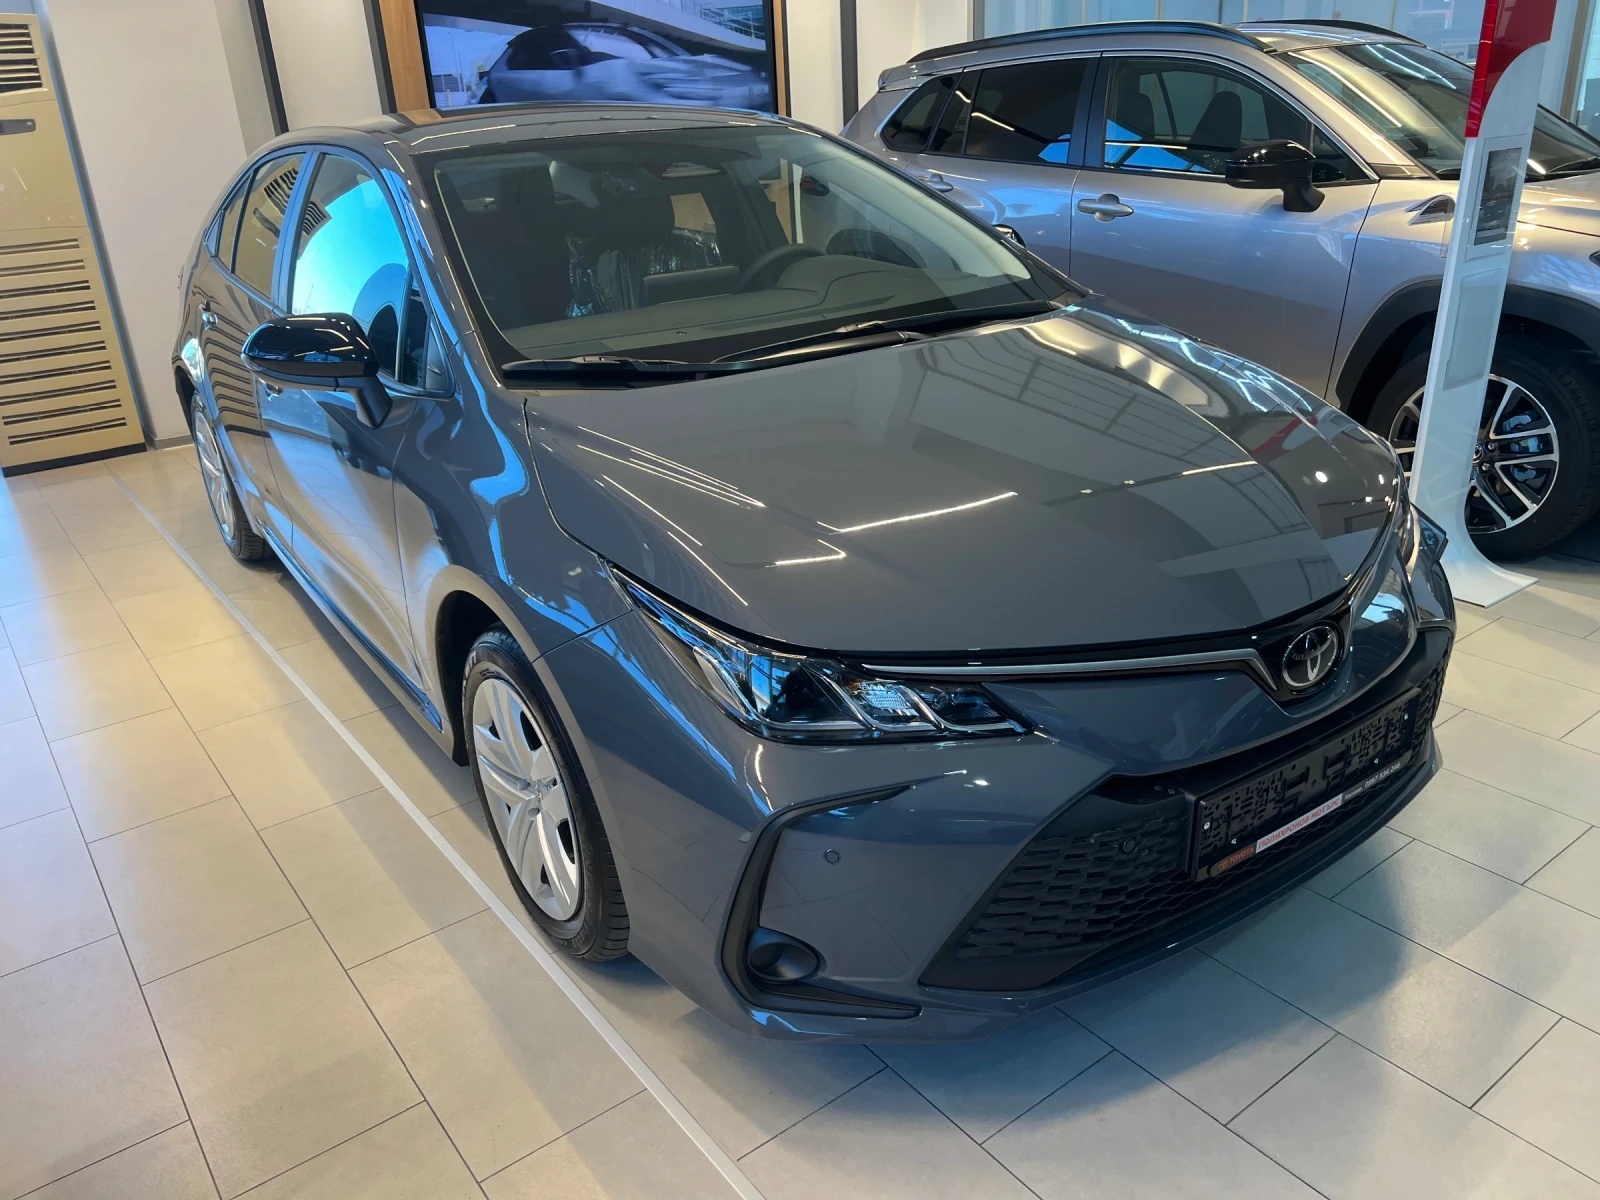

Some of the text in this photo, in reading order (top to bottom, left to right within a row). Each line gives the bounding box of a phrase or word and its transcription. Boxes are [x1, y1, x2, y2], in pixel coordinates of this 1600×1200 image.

[1228, 847, 1255, 864] TOYOTA
[1258, 816, 1310, 849] ПОЛИХРОНОВ
[1310, 798, 1341, 818] МОТЪРС
